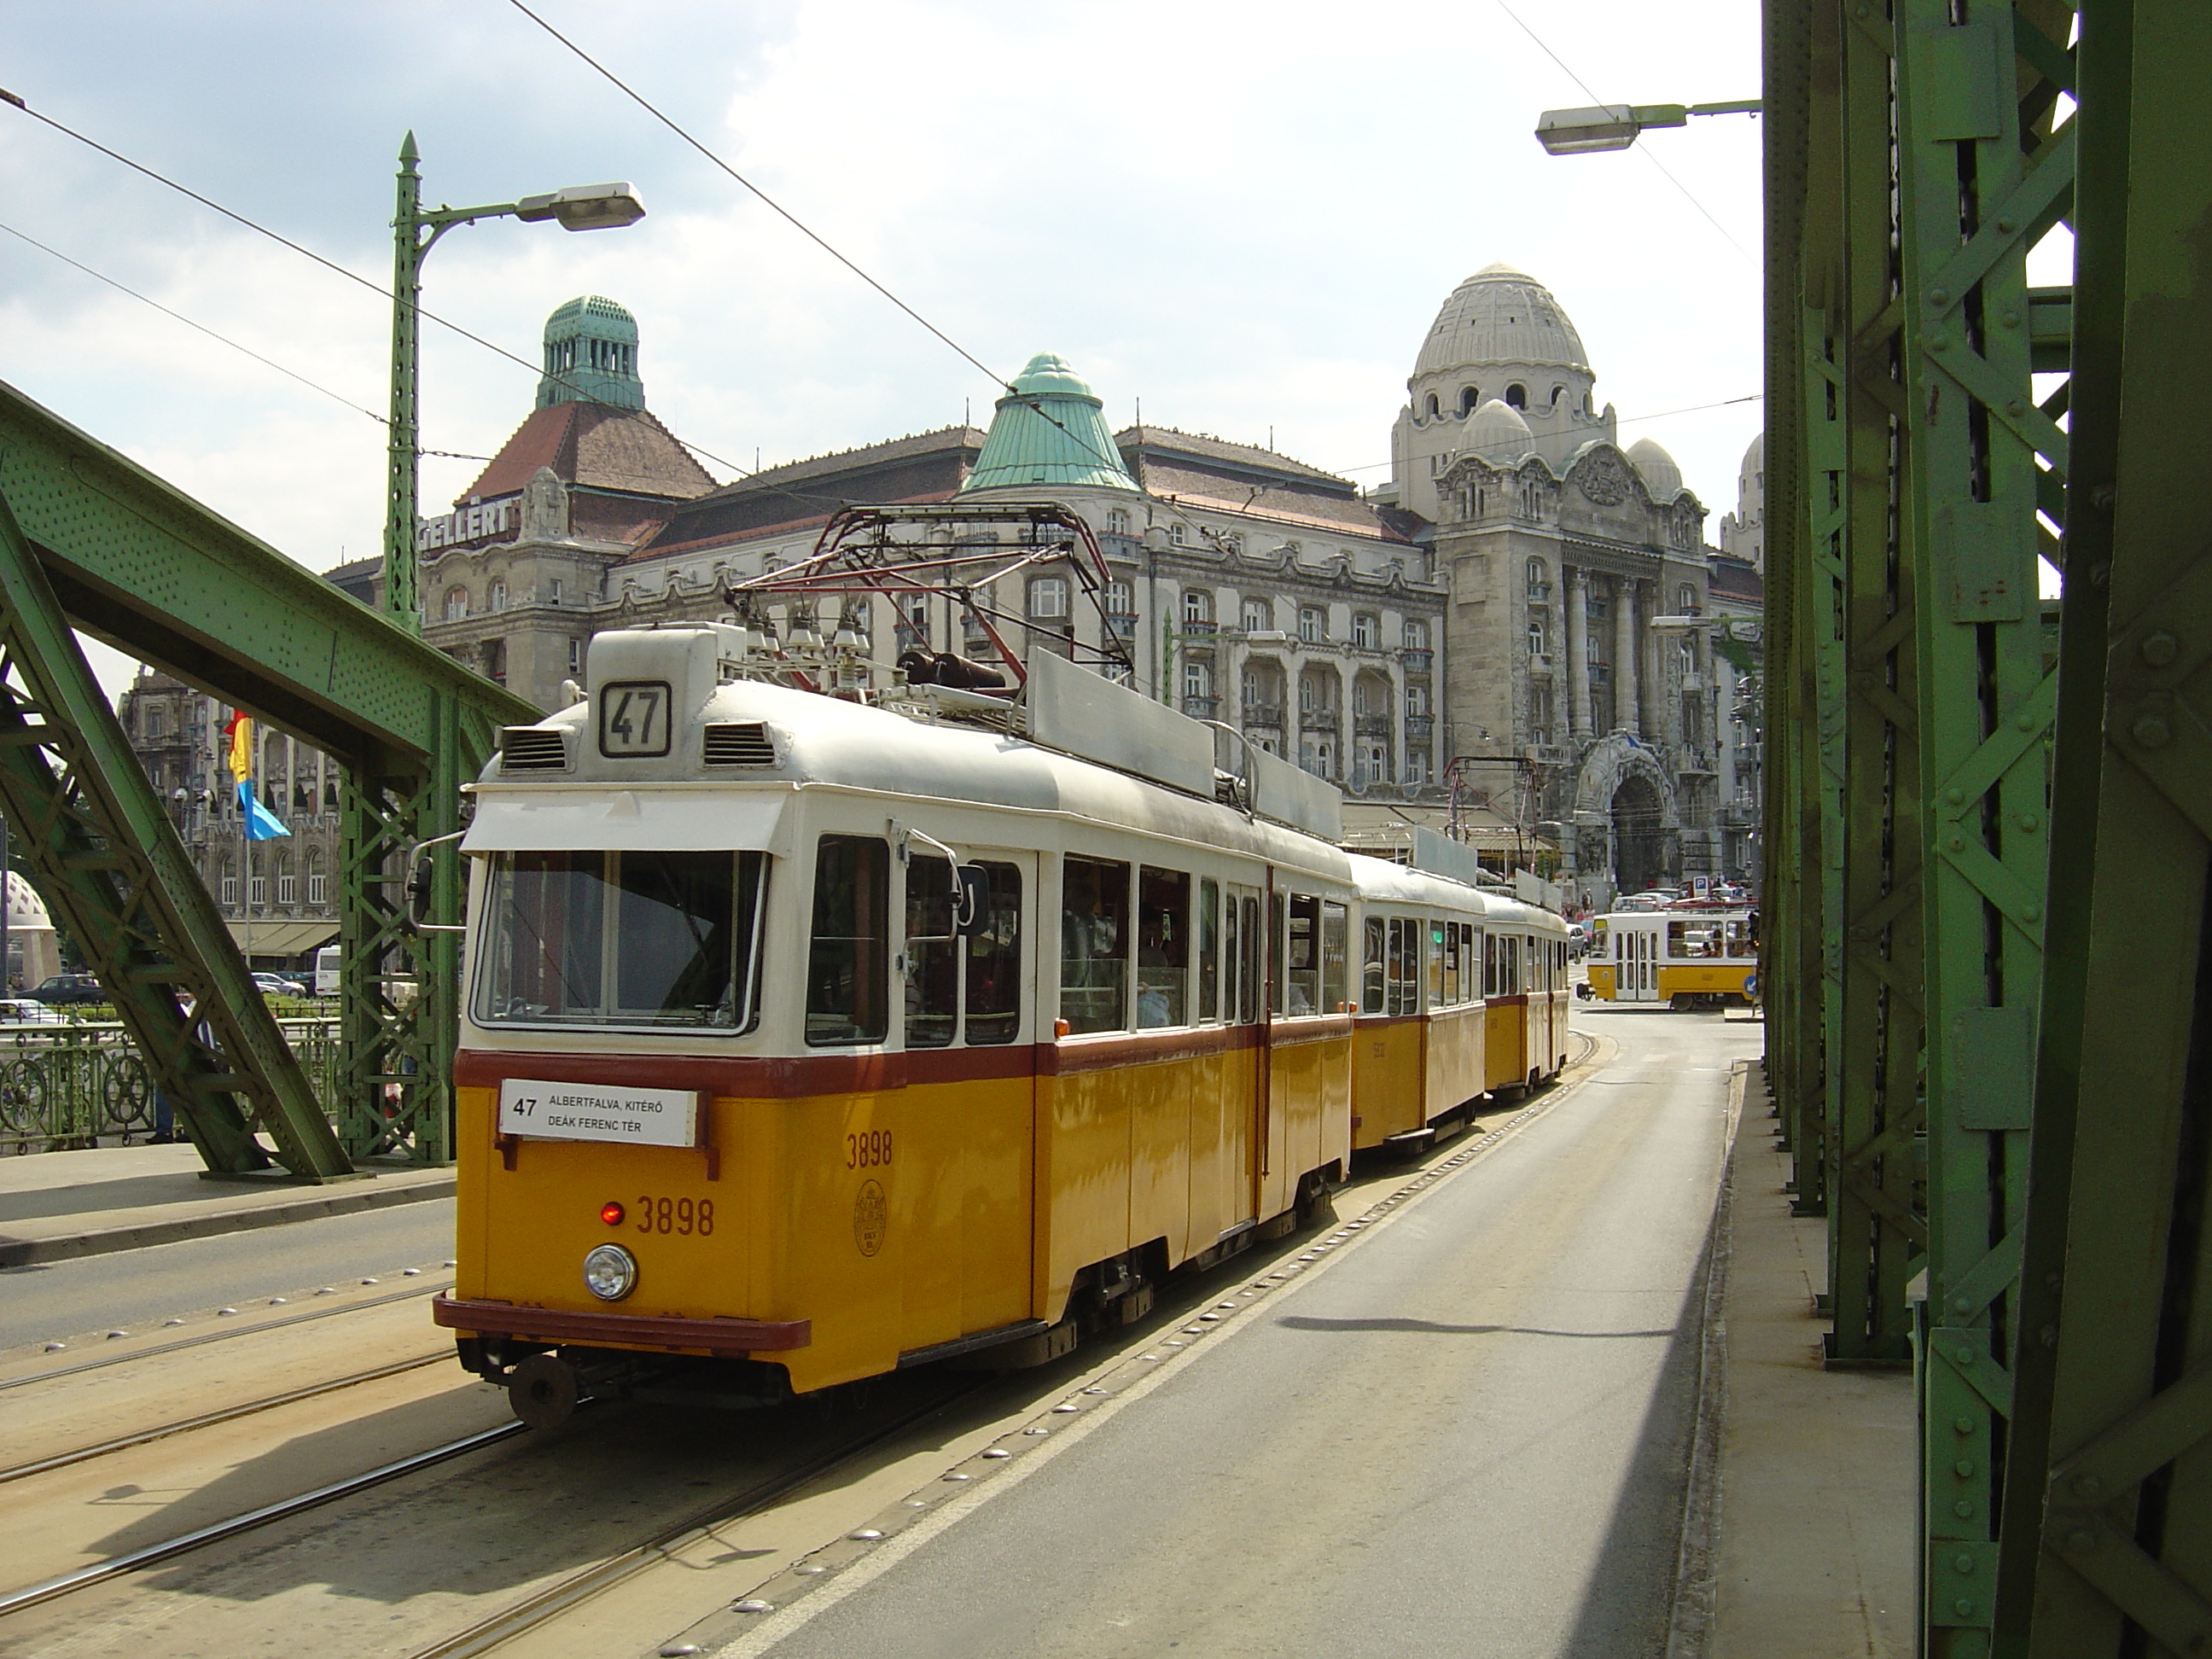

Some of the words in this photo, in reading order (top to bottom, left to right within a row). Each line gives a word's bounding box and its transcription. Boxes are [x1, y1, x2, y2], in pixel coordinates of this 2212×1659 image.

[610, 690, 661, 745] 47
[513, 1097, 538, 1117] 47
[549, 1095, 622, 1112] ALBERTFALVA,
[625, 1099, 663, 1113] KITÉRŐ
[548, 1115, 576, 1127] DEÁK
[578, 1117, 619, 1131] FERENC
[621, 1119, 642, 1132] TÉR
[847, 1129, 893, 1170] 3898
[637, 1195, 714, 1237] 3898
